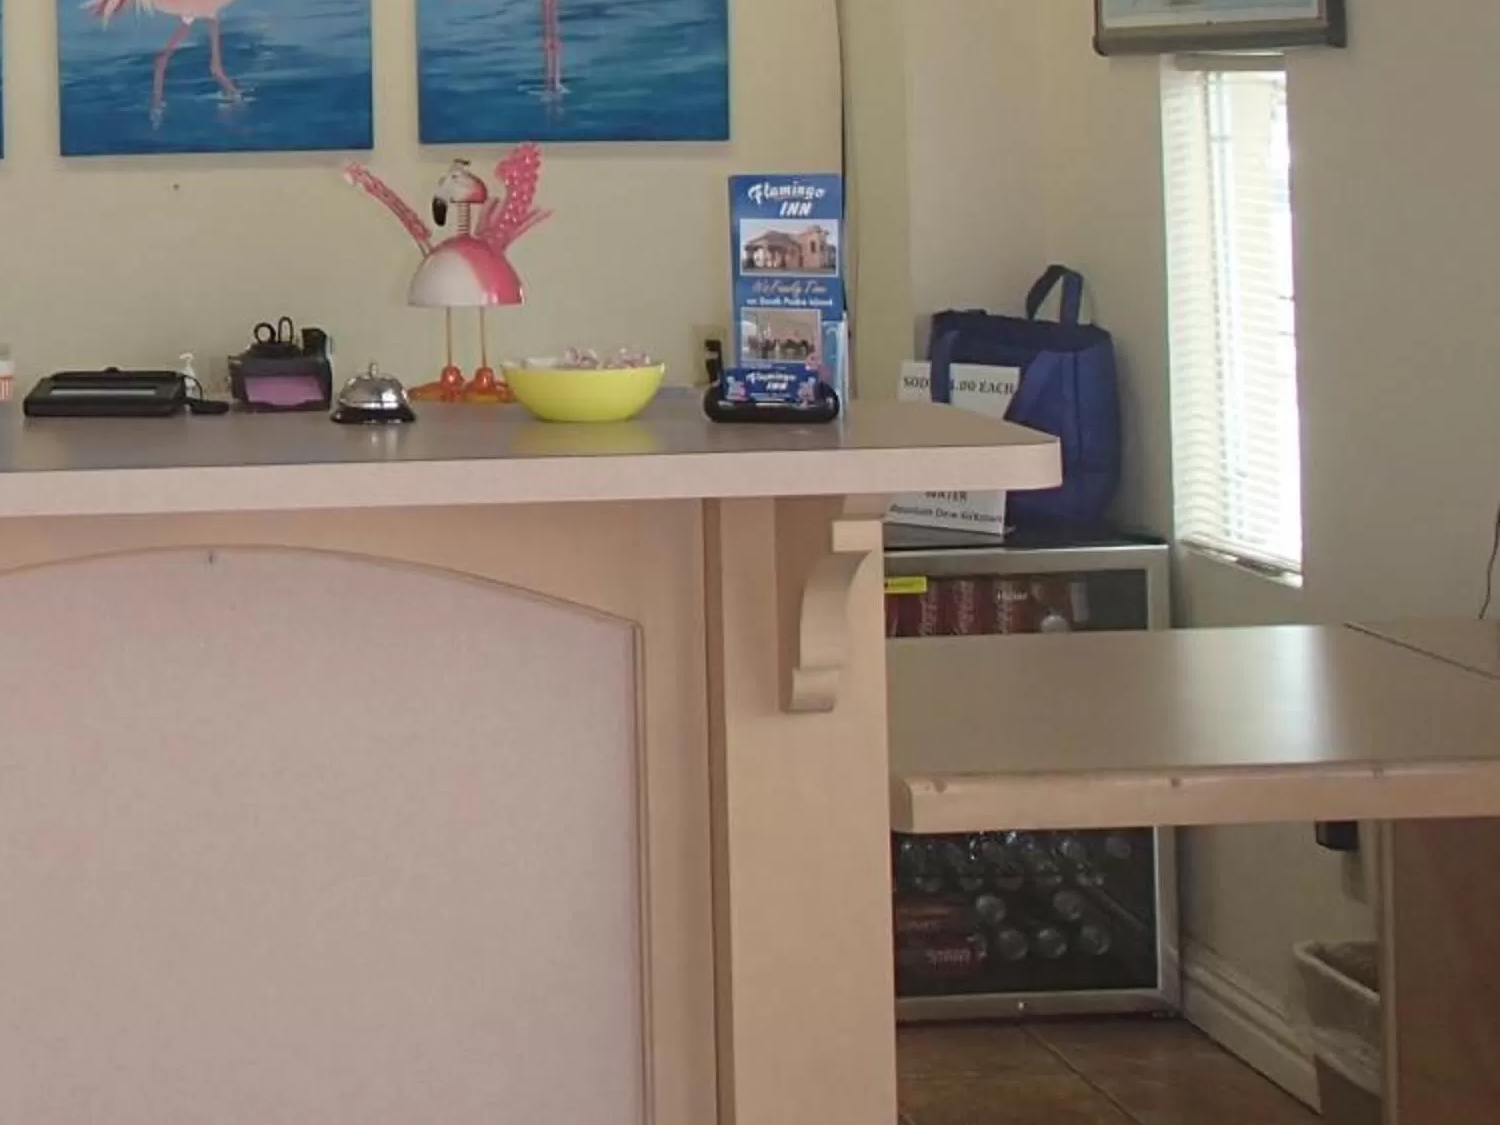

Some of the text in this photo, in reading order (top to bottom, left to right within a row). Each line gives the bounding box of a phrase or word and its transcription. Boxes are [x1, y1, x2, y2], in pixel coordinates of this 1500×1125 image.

[748, 180, 826, 205] Flamingo
[779, 201, 813, 217] INN
[979, 378, 1014, 396] EACH
